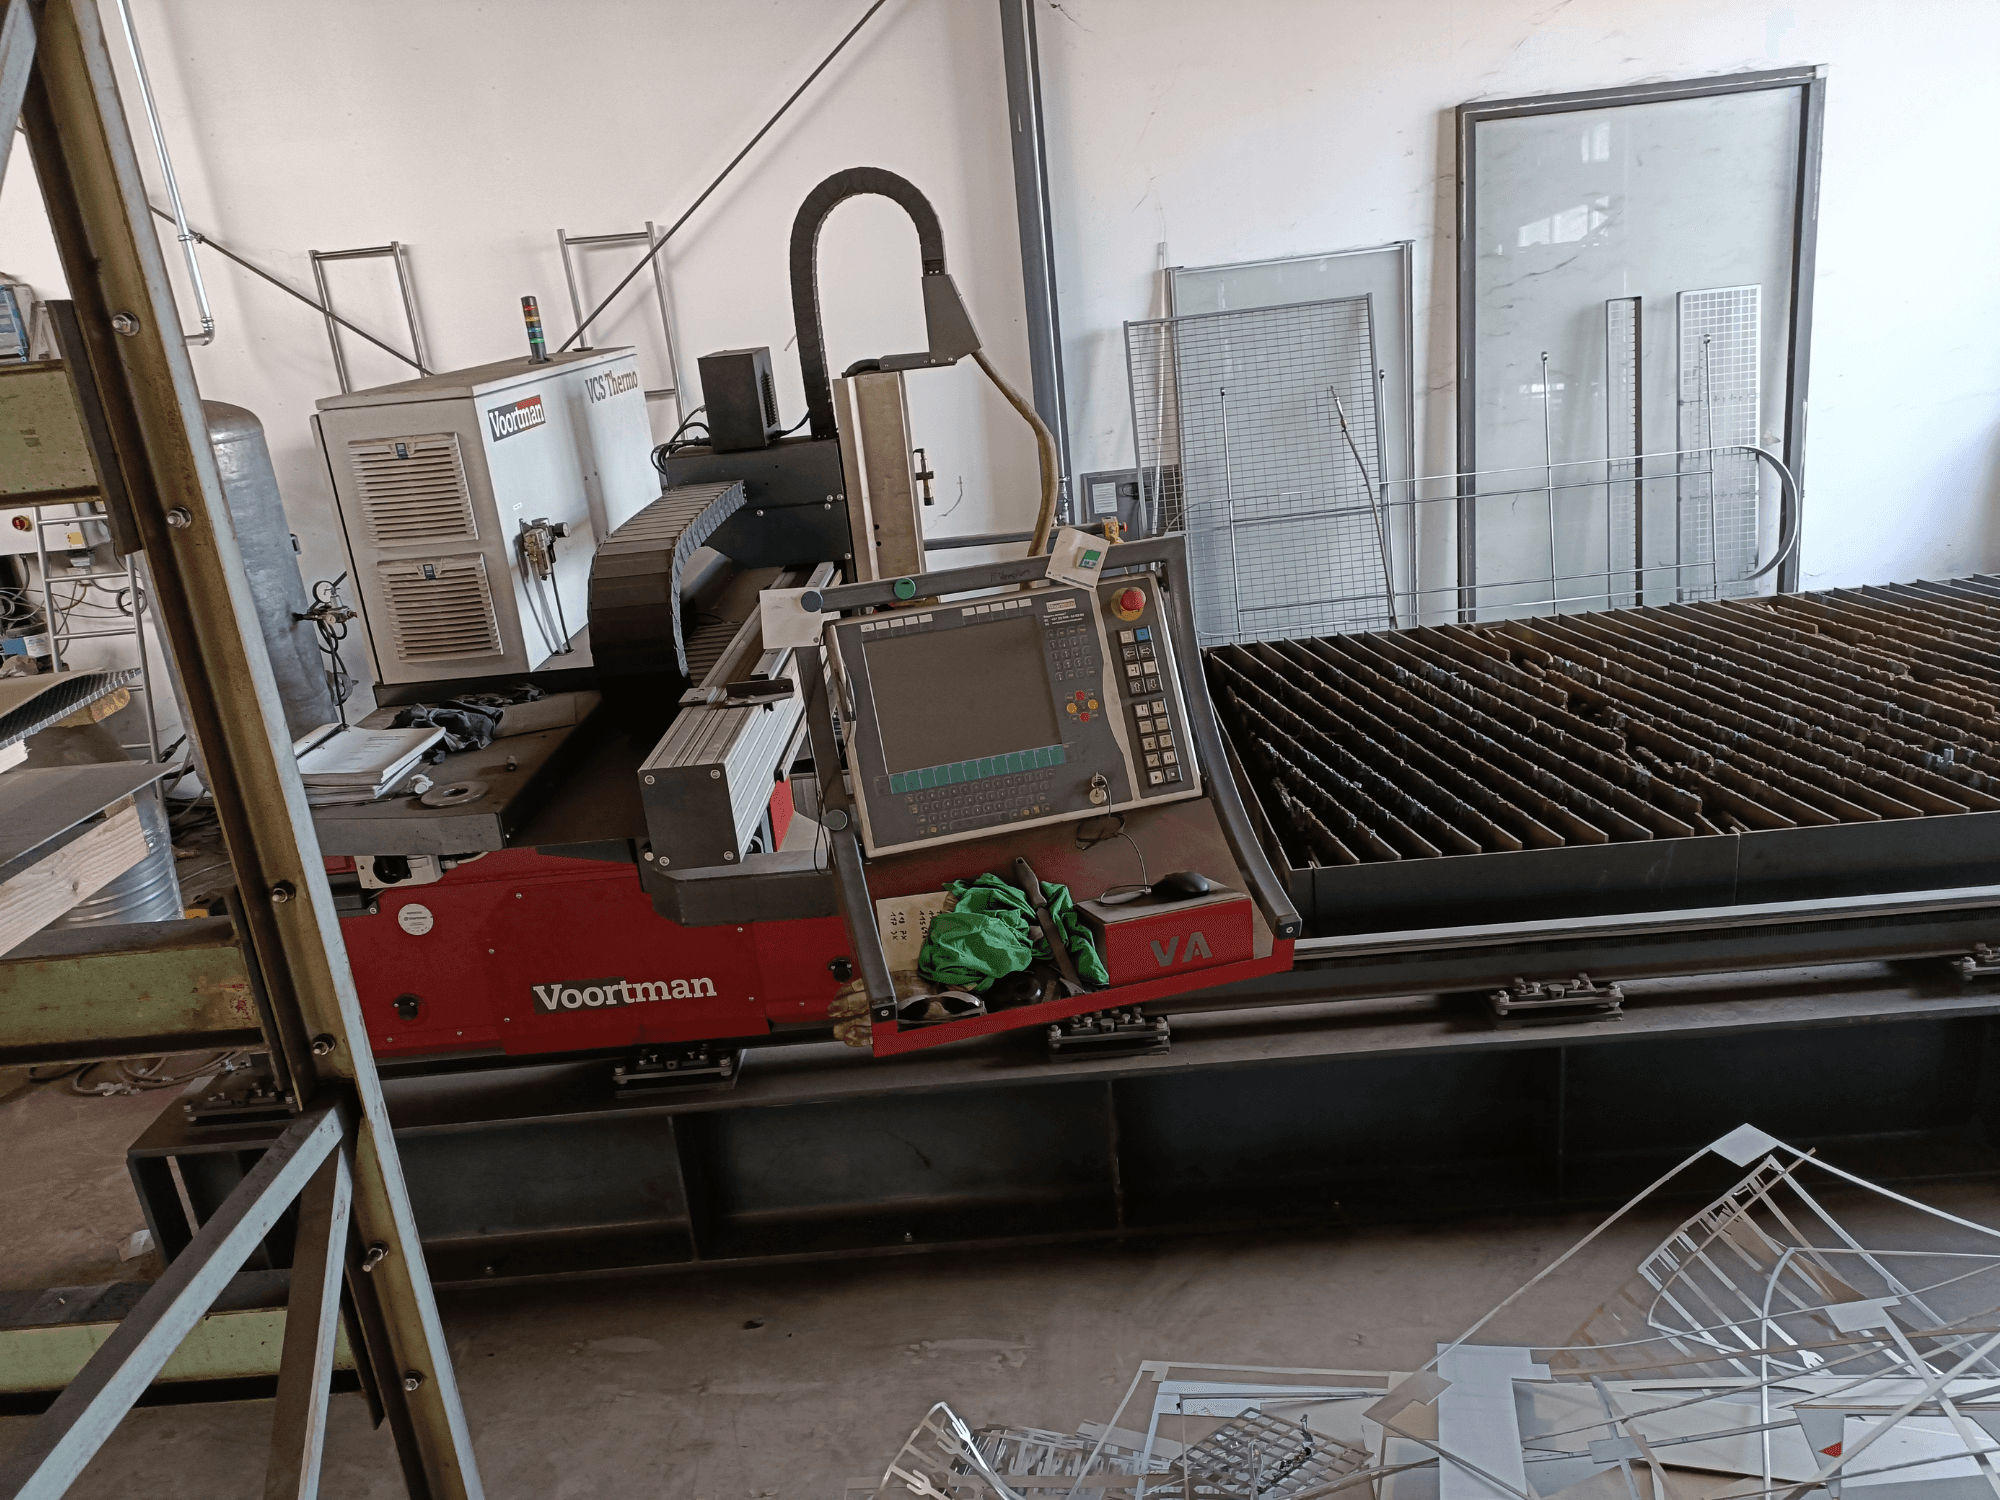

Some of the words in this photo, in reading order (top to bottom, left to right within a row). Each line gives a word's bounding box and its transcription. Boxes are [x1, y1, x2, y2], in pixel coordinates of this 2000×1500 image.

[585, 374, 606, 403] VCS
[604, 370, 638, 397] Thermo
[488, 403, 545, 437] Voortman
[1150, 931, 1213, 967] VA
[533, 977, 717, 1010] Voortman
